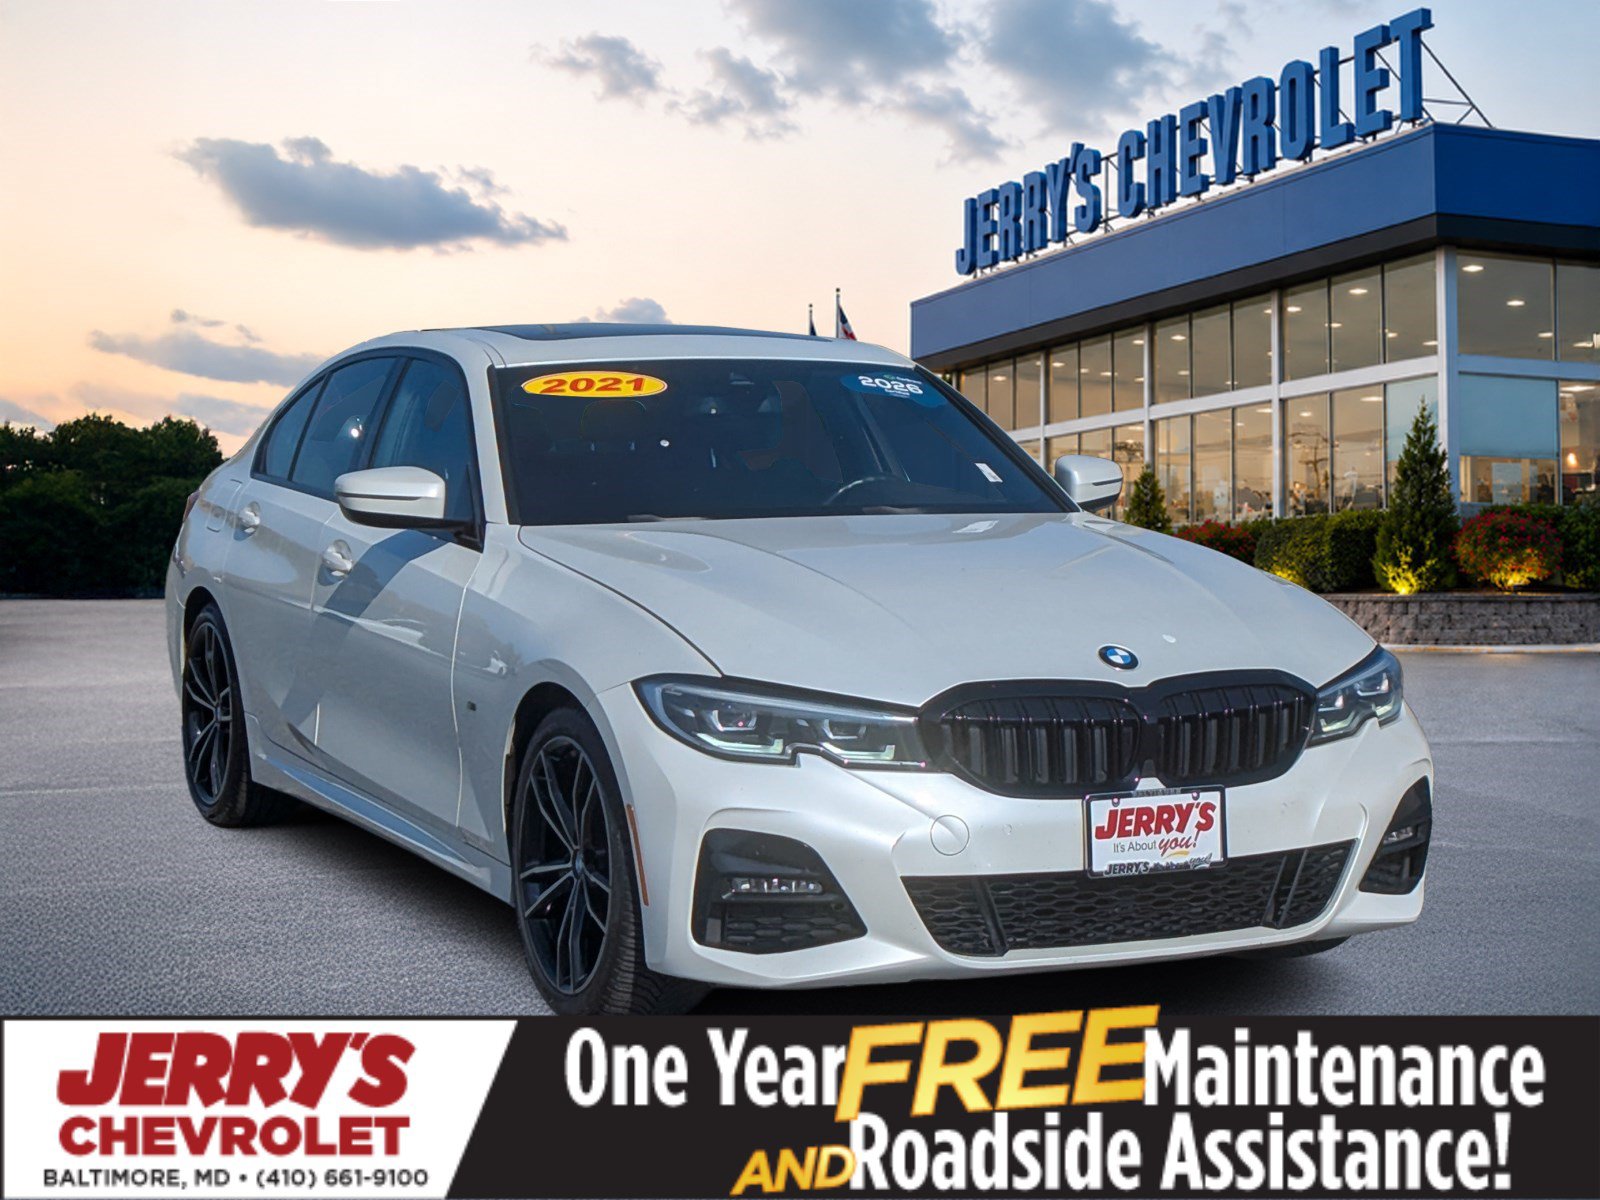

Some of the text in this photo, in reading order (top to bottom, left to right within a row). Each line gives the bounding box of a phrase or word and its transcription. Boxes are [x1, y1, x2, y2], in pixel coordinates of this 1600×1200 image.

[956, 8, 1434, 275] JERRY'S CHEVROLET
[539, 377, 646, 393] 2021
[1095, 801, 1216, 840] JERRY'S
[1113, 829, 1201, 857] It's About you!
[1103, 861, 1150, 876] JERRY'S
